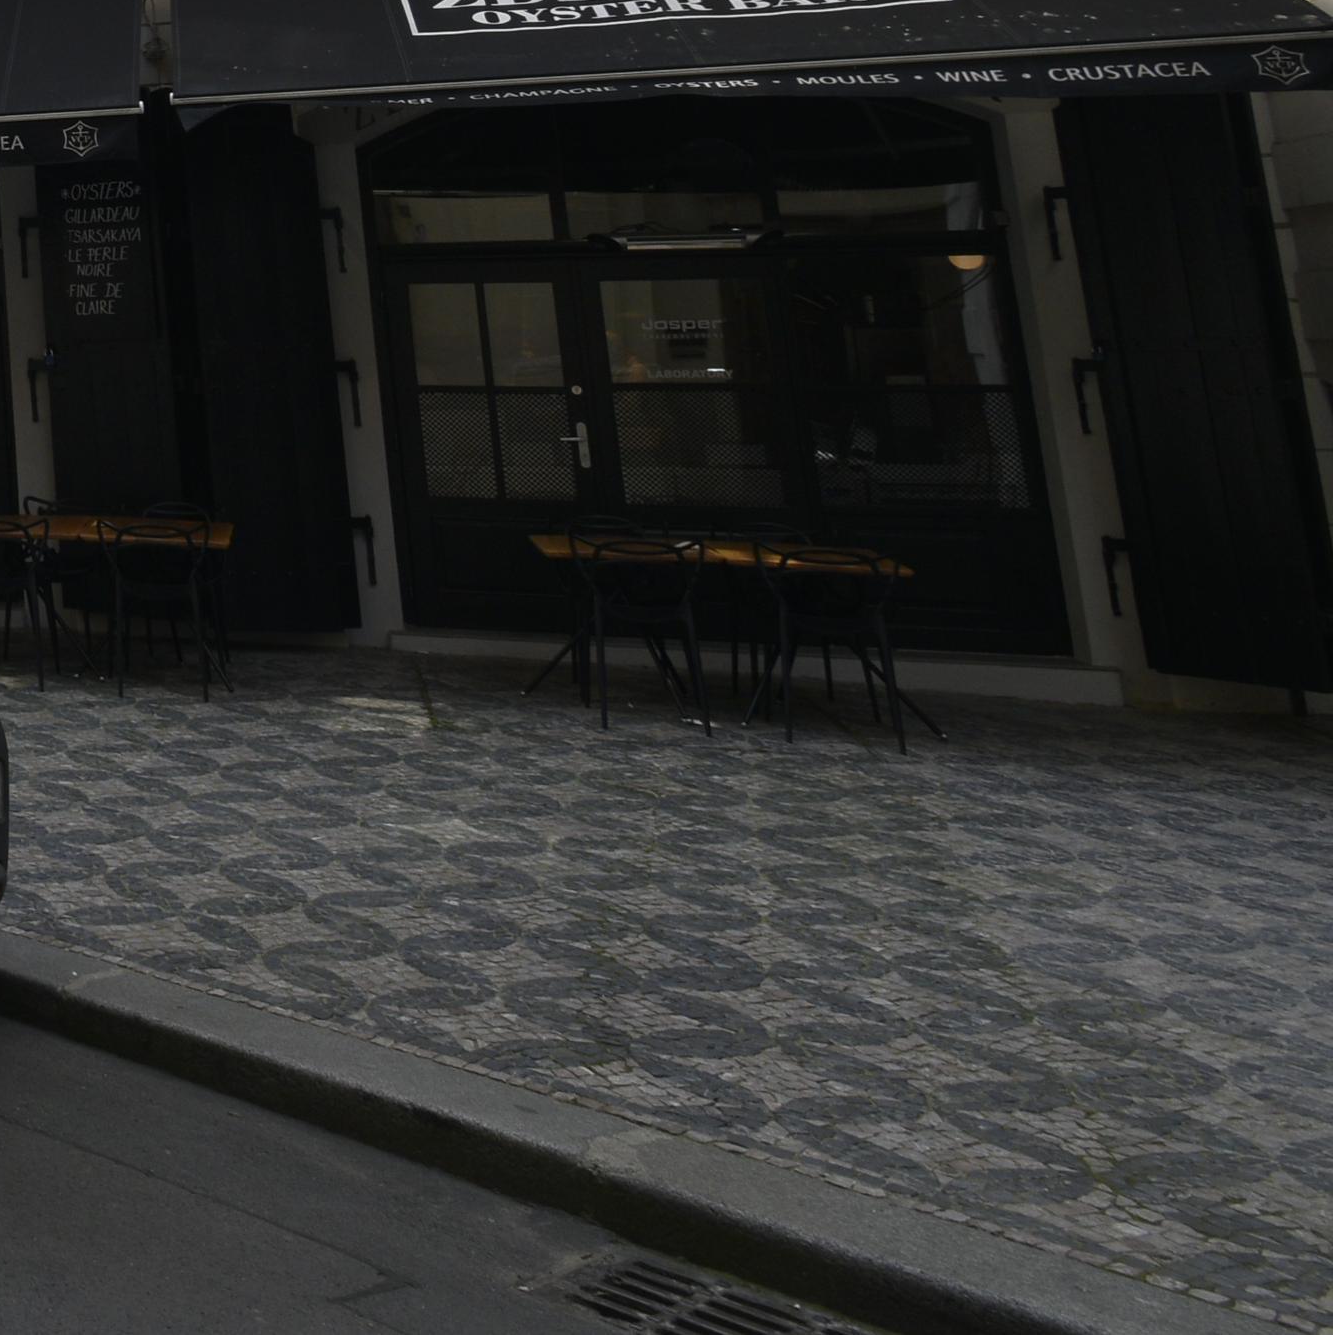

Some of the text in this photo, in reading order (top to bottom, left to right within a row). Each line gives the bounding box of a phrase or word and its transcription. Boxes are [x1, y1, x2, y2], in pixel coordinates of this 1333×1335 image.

[469, 84, 618, 101] CHAMPAGNE
[653, 77, 759, 90] OYSTERS
[796, 72, 900, 85] MOULES
[936, 68, 1007, 83] WINE
[1048, 60, 1212, 83] CRUSTACEA
[641, 317, 723, 332] Josper
